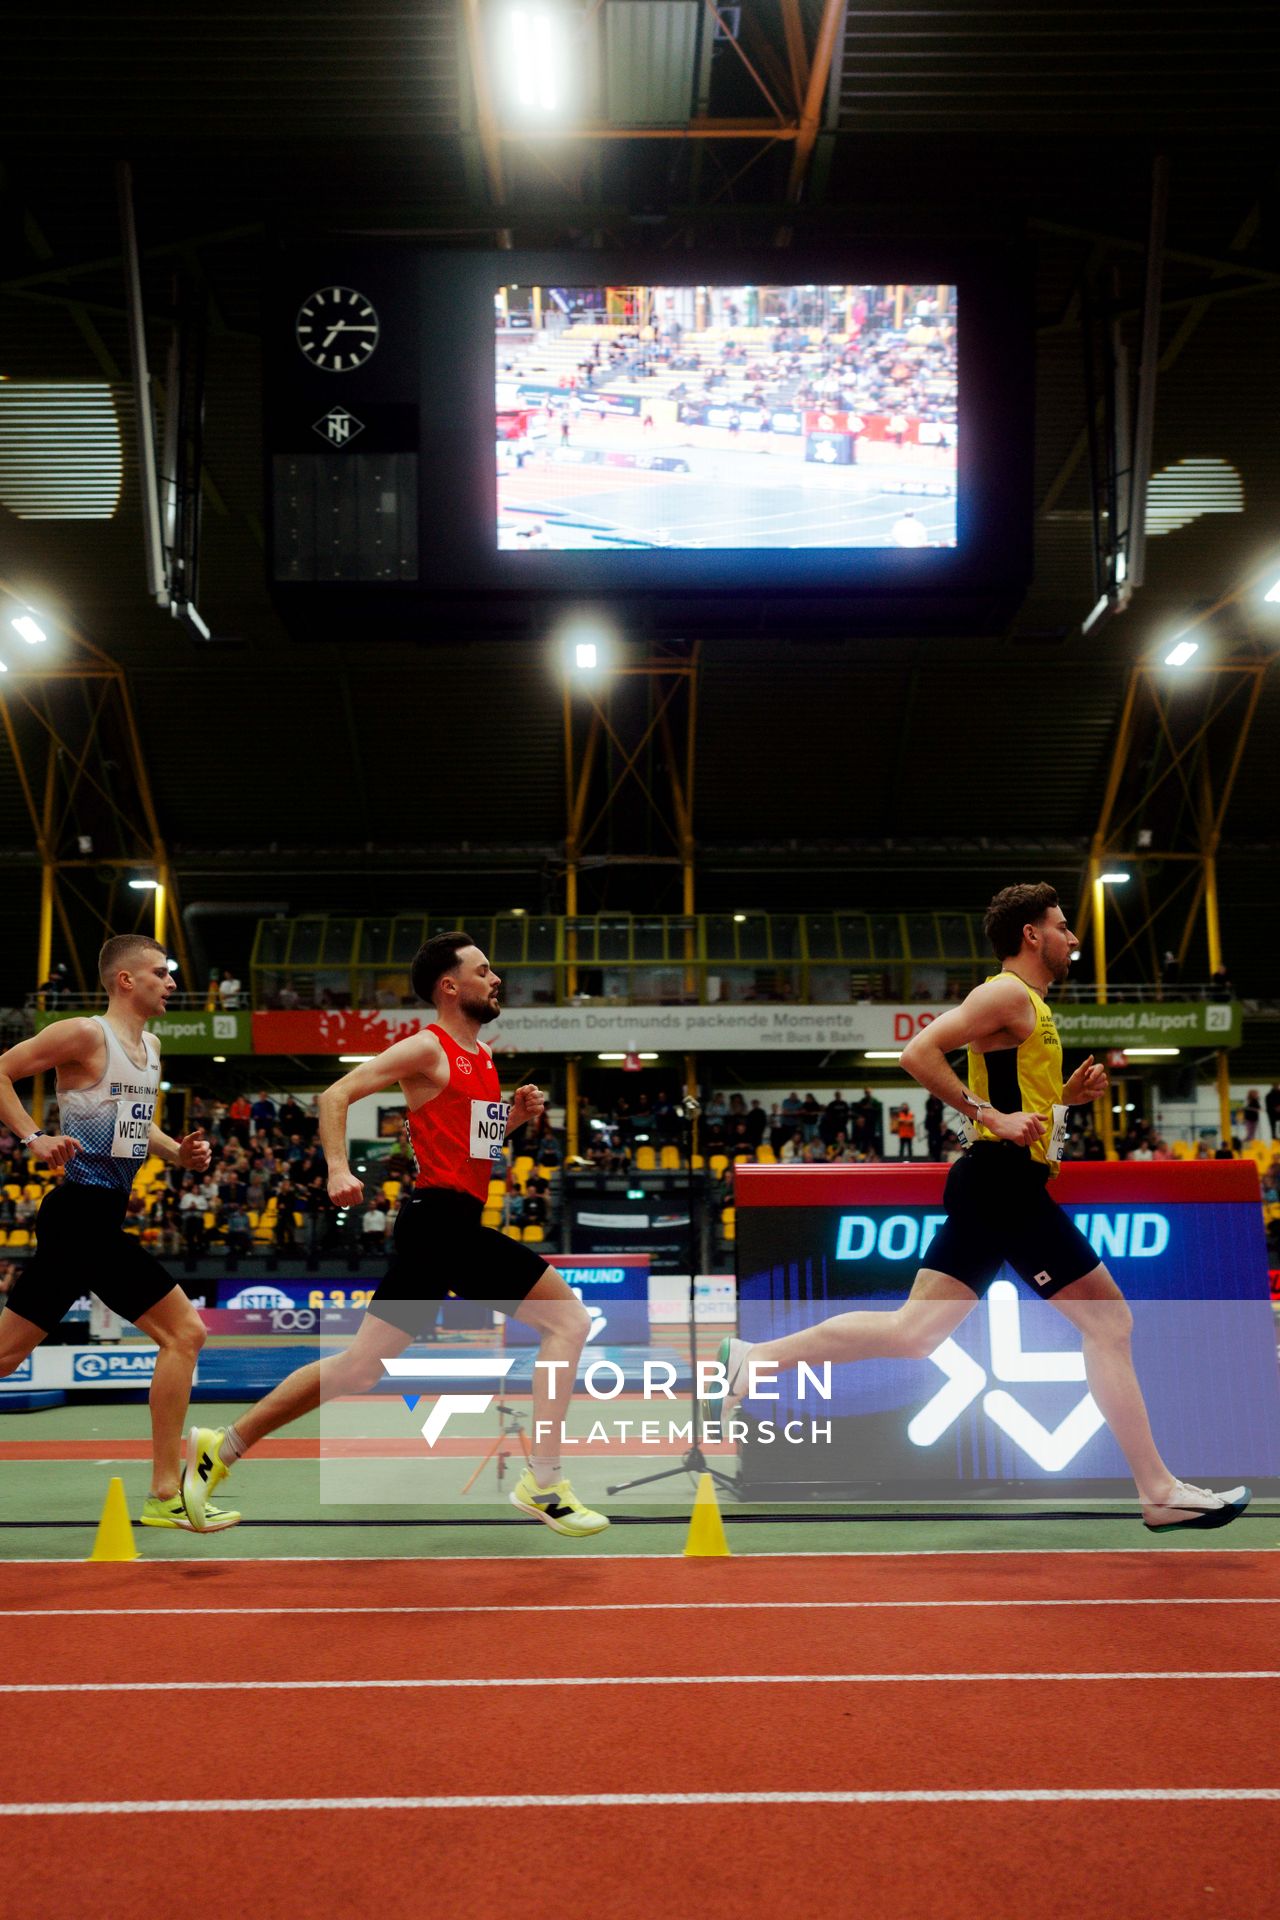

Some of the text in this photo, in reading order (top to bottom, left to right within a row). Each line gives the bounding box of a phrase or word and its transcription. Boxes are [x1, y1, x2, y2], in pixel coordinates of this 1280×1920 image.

[152, 1020, 206, 1039] Airport
[496, 1013, 581, 1030] verbinden
[586, 1013, 681, 1029] Dortmunds
[686, 1013, 768, 1031] packende
[773, 1013, 853, 1027] Momente
[1054, 1013, 1134, 1030] Dortmund
[1137, 1012, 1198, 1032] Airport
[760, 1031, 866, 1043] mit Bus & Bahn
[131, 1103, 153, 1121] GLS
[268, 1309, 316, 1330] 100
